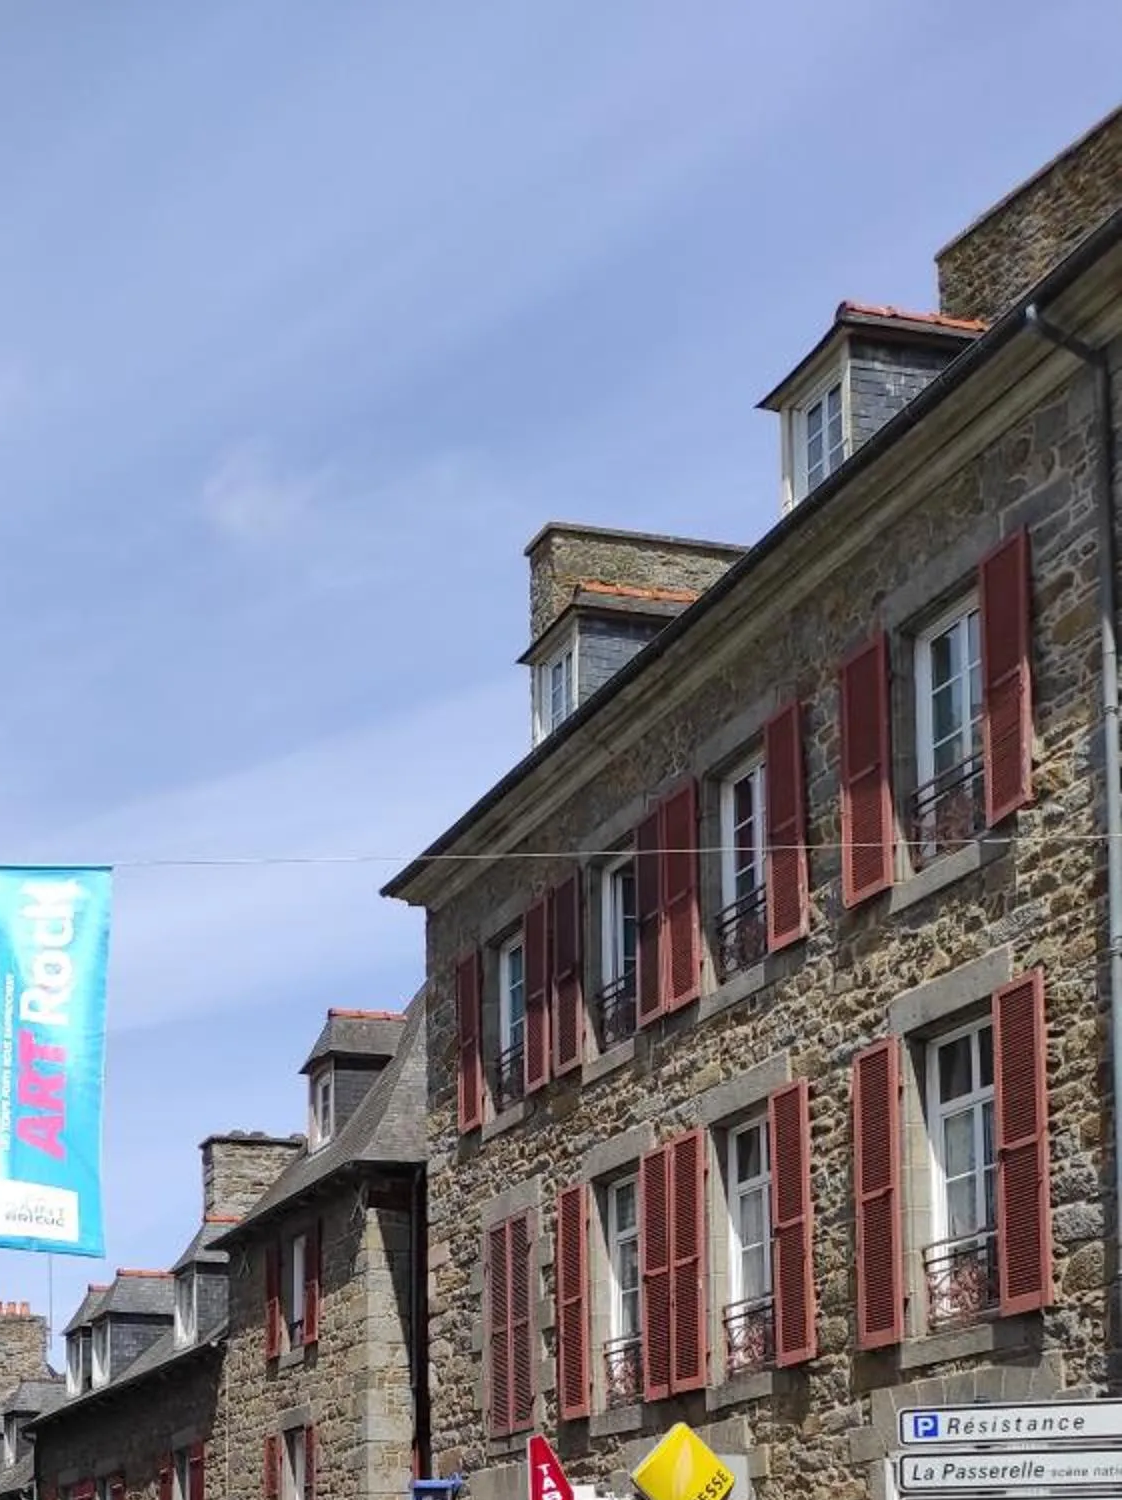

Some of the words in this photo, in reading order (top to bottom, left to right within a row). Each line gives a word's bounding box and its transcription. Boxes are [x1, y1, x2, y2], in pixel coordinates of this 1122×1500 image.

[16, 1029, 67, 1161] ART
[917, 1418, 935, 1437] P
[946, 1416, 1085, 1435] Résistance
[912, 1464, 935, 1481] La
[942, 1460, 1045, 1480] Passerelle
